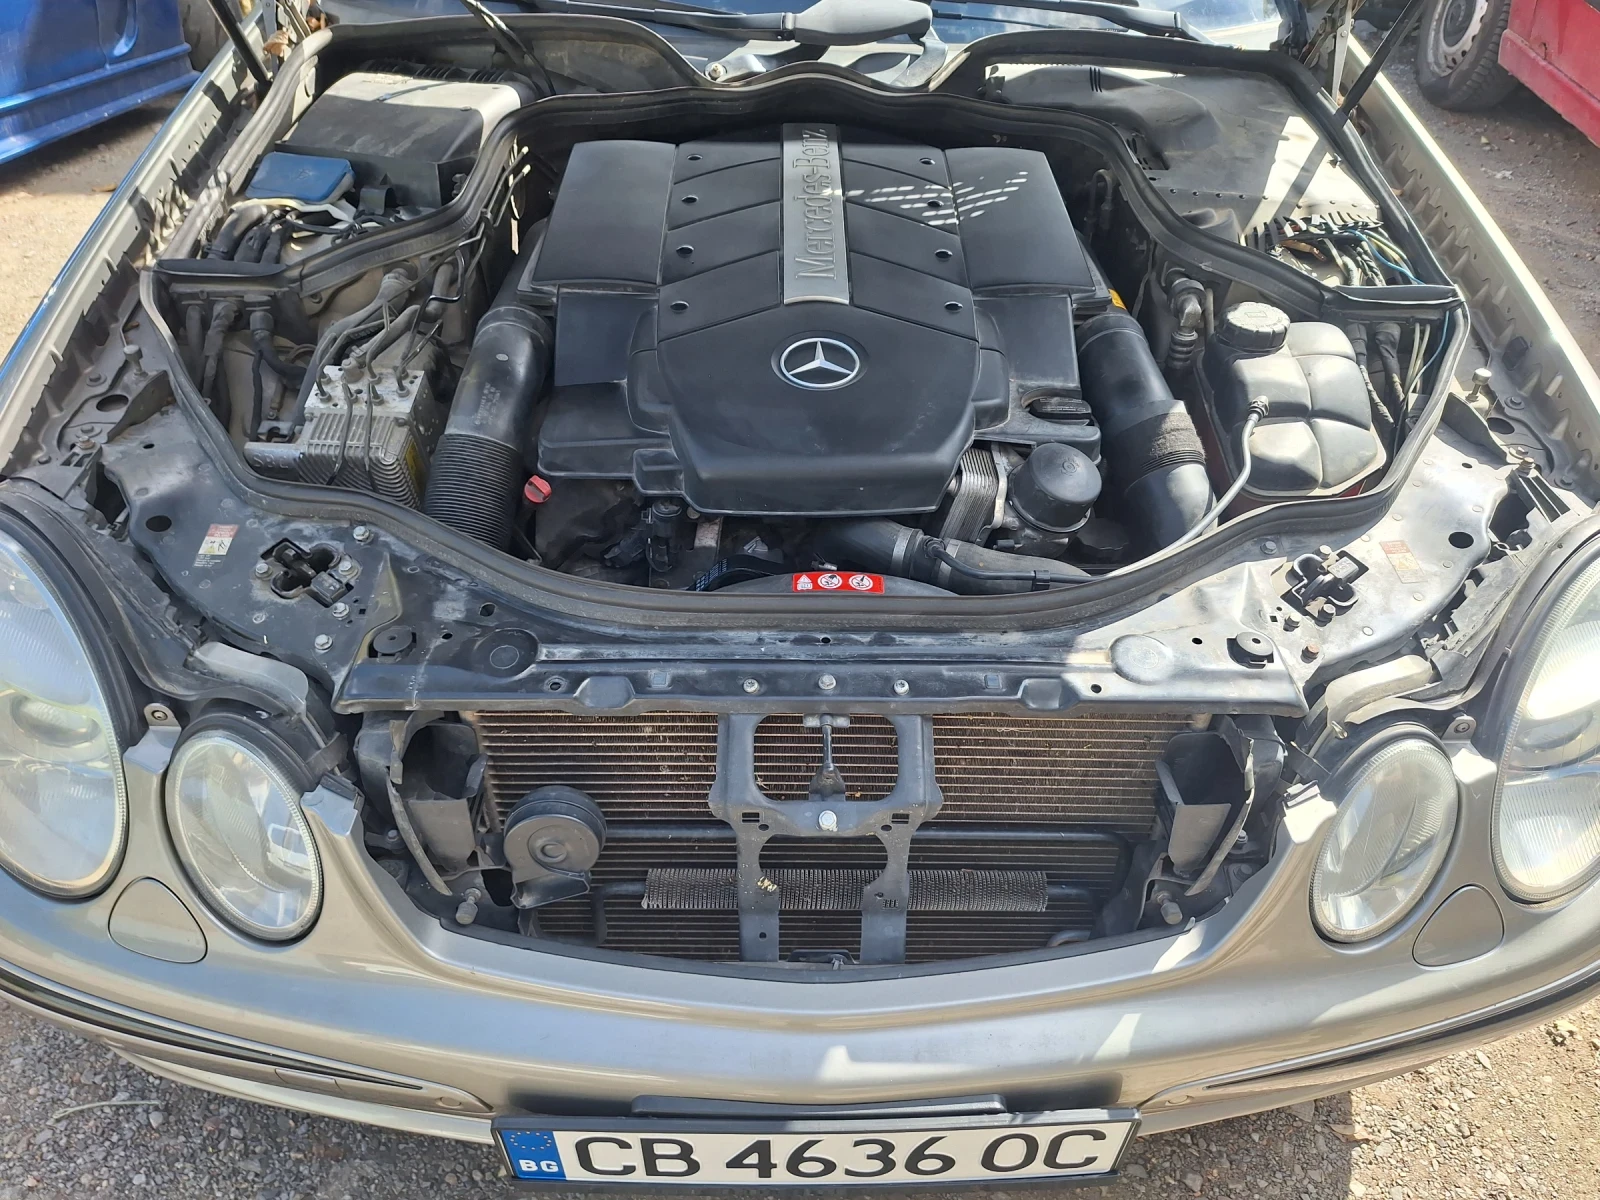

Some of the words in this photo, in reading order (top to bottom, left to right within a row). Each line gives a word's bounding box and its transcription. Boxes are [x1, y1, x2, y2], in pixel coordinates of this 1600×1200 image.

[793, 128, 838, 280] Mercedes-Benz
[518, 1159, 559, 1172] BG
[575, 1136, 700, 1178] CB
[725, 1135, 956, 1179] 4636
[980, 1129, 1107, 1172] OC
